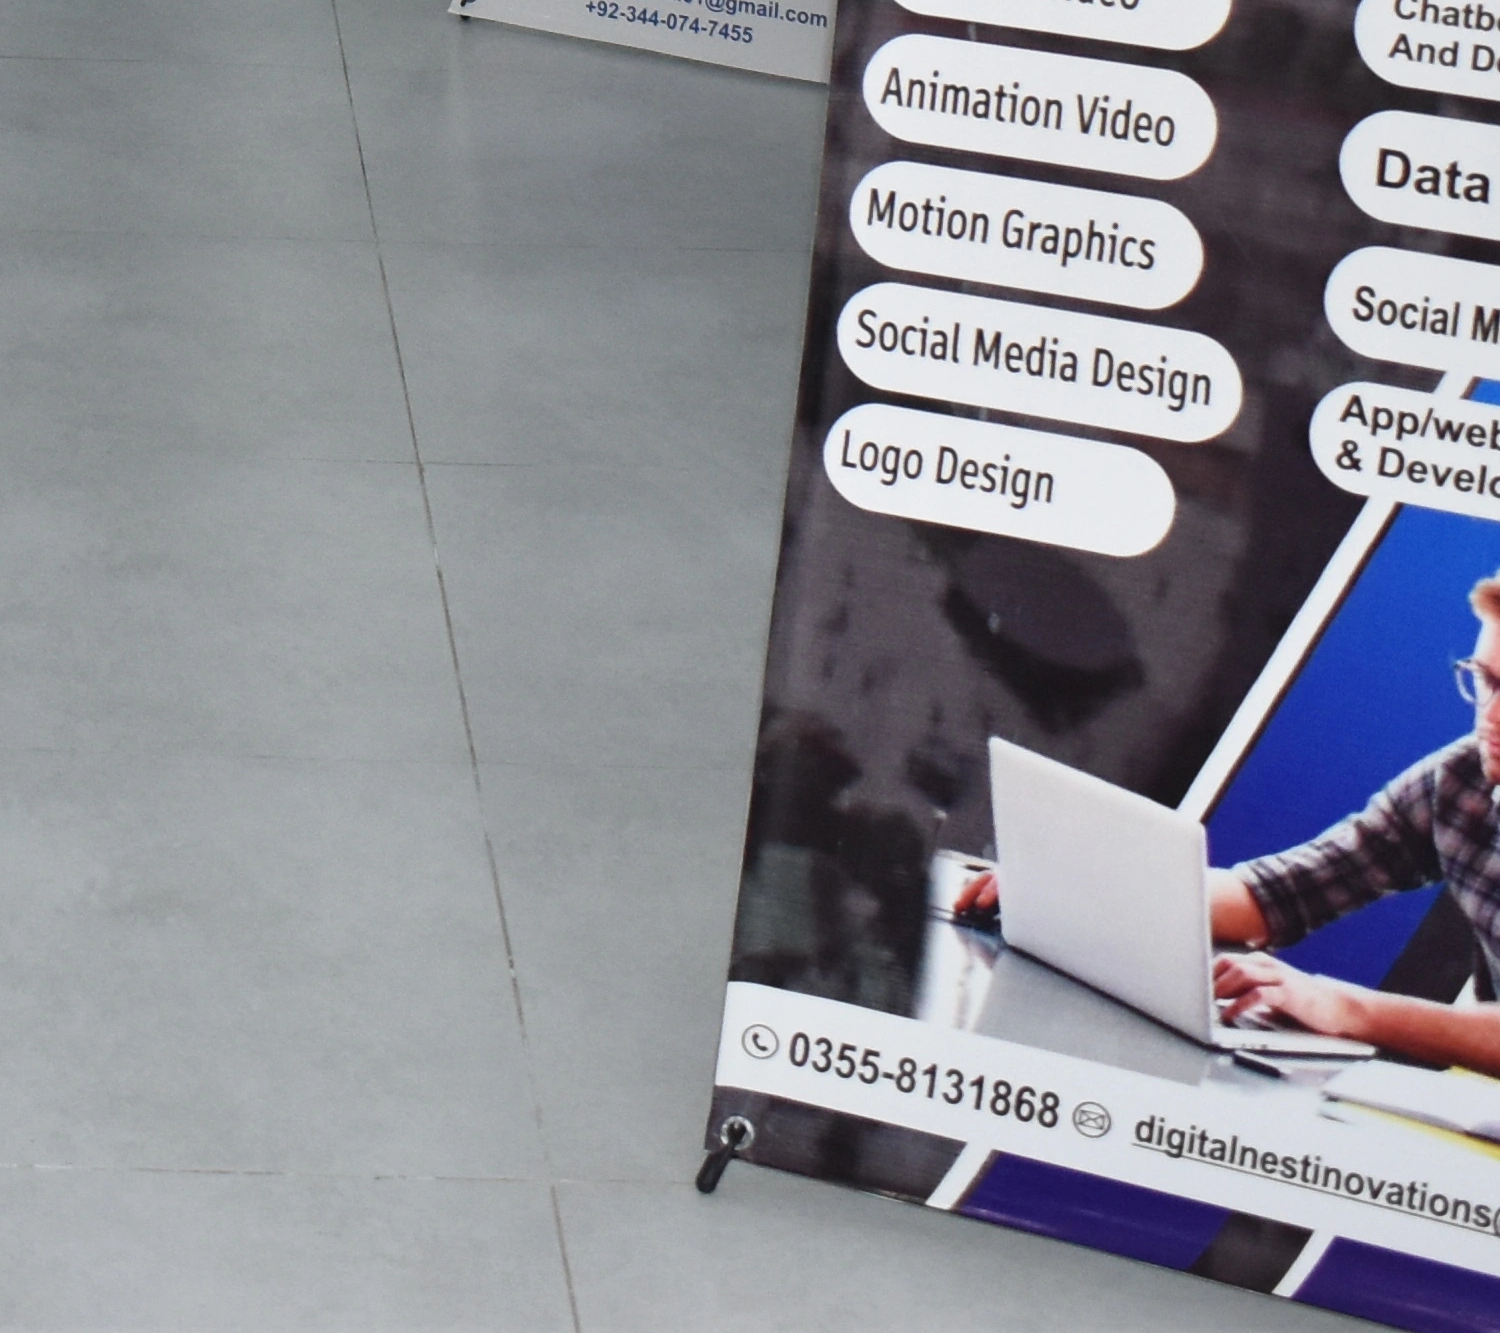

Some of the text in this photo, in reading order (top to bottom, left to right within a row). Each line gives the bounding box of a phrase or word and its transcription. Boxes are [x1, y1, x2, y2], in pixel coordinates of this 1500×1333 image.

[586, 1, 752, 43] +92-344-074-7455
[1389, 34, 1459, 67] And
[881, 68, 1174, 146] Animation Video
[1377, 149, 1489, 204] Data
[868, 189, 1155, 270] Motion Graphics
[1353, 286, 1460, 337] Social
[856, 310, 1211, 412] Social Media Design
[842, 430, 1053, 509] Logo Design
[1336, 440, 1362, 471] &
[790, 1033, 1059, 1128] 0355-8131868
